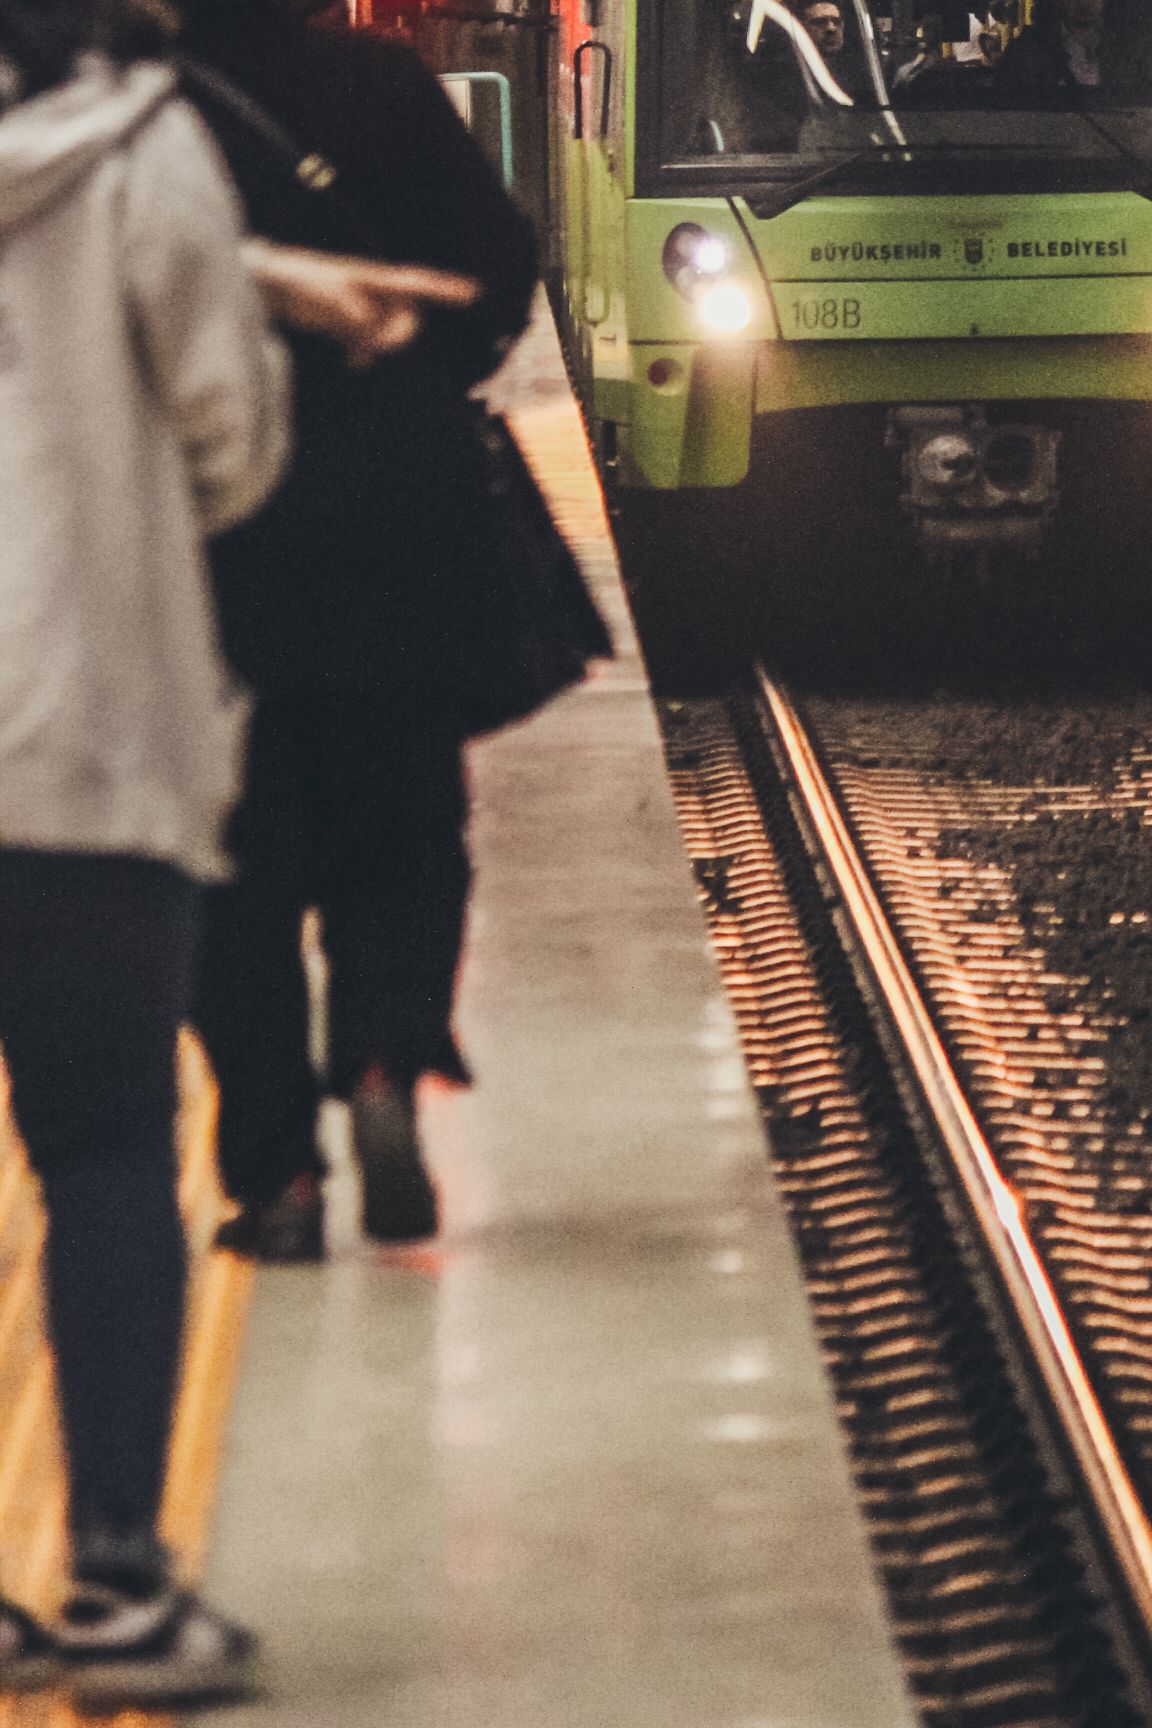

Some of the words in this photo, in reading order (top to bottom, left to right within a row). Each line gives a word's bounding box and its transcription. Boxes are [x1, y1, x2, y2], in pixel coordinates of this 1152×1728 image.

[810, 239, 942, 263] BÜYÜKŞEHİR
[1007, 237, 1127, 258] BELEDİYESİ
[791, 298, 862, 329] 108B
